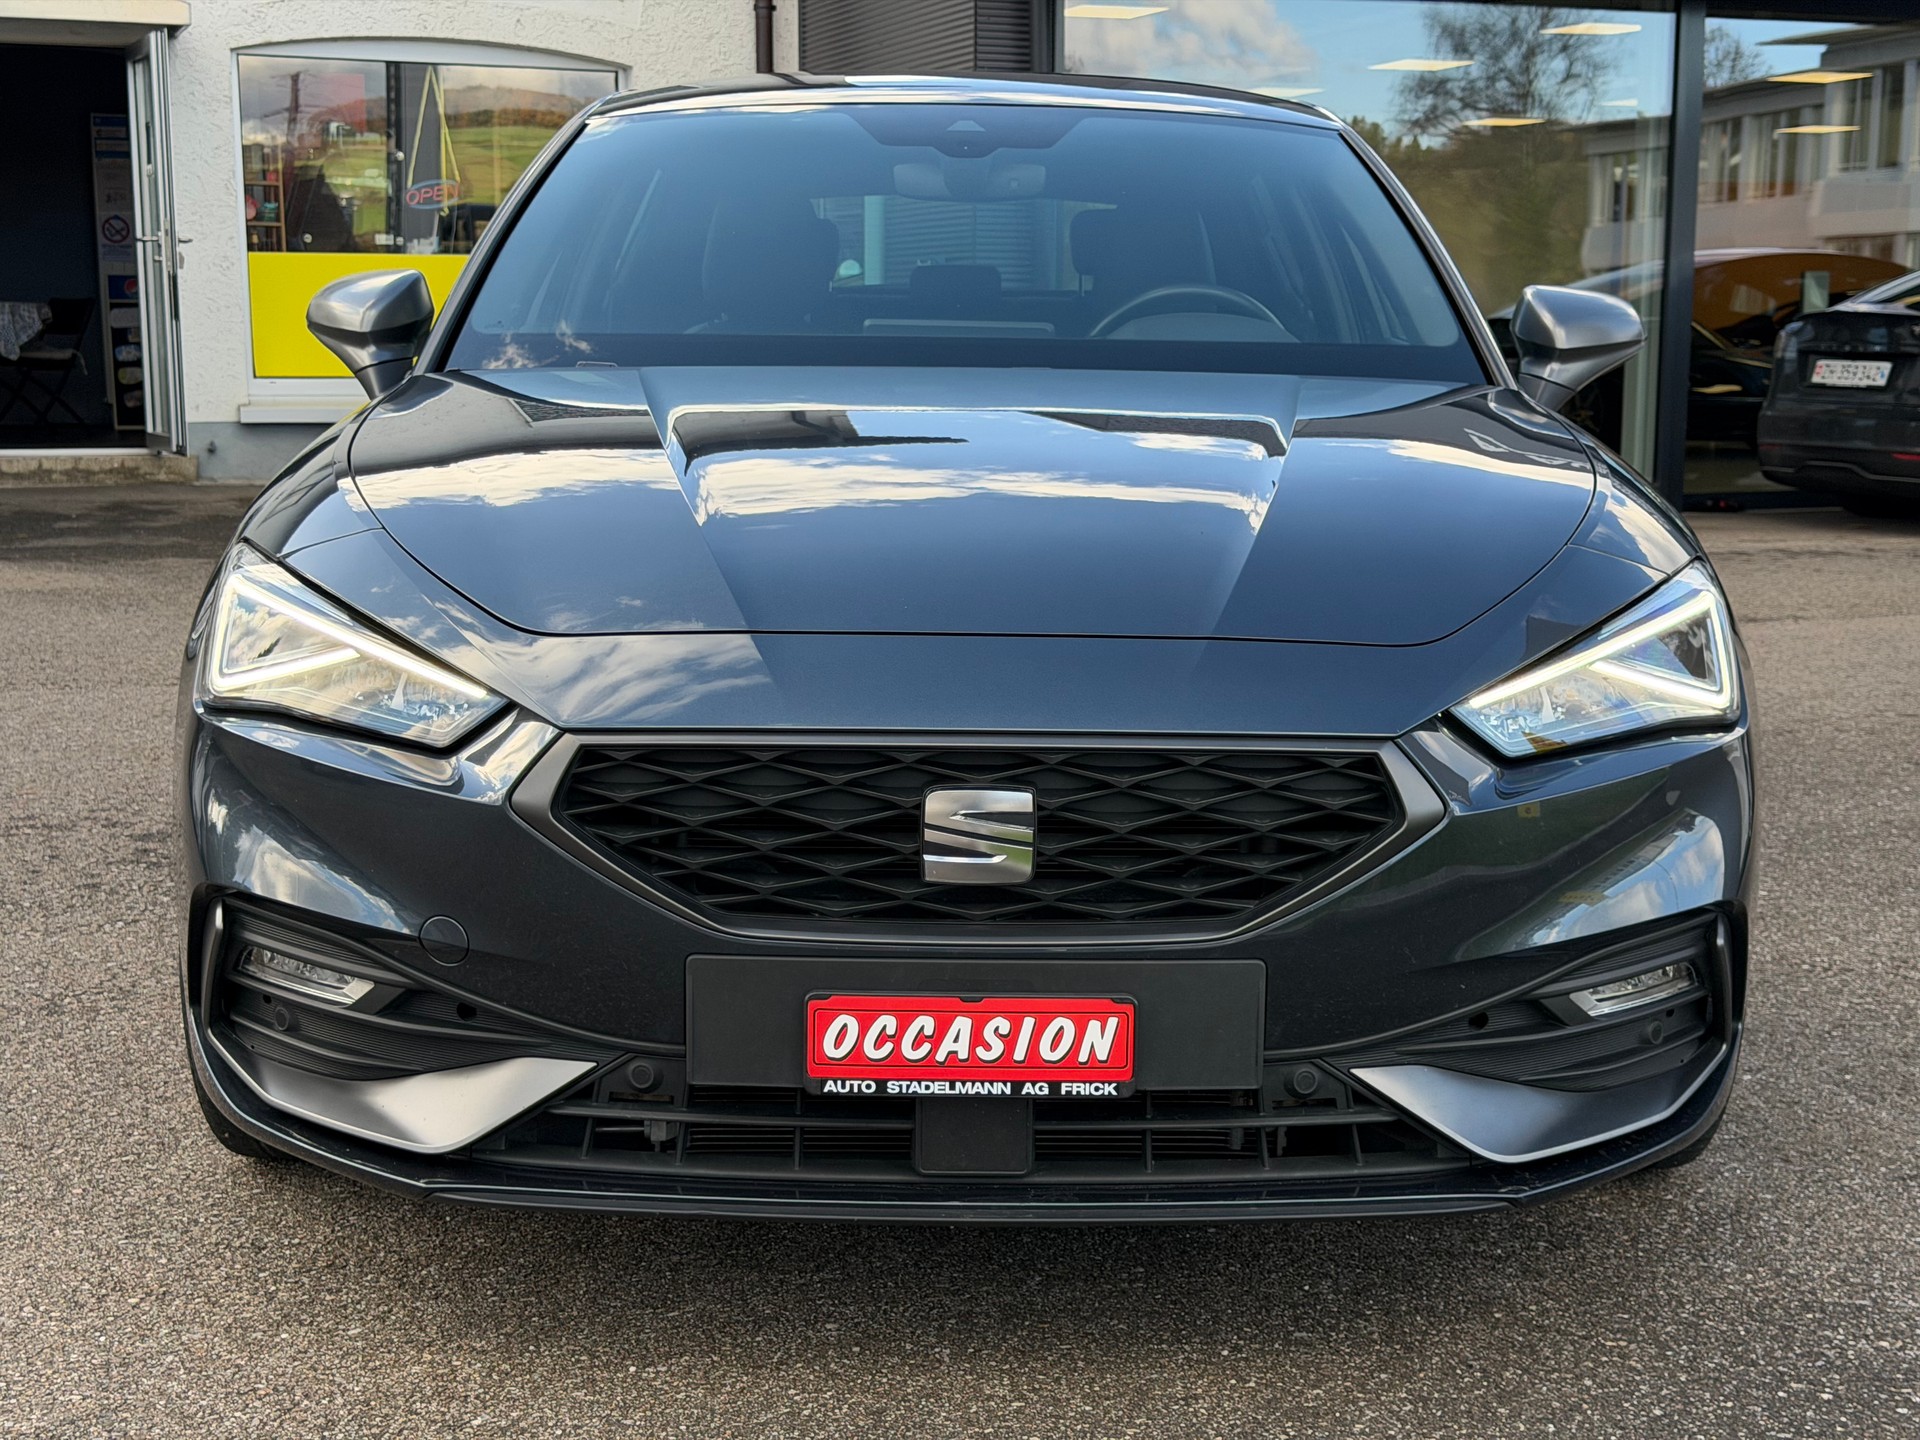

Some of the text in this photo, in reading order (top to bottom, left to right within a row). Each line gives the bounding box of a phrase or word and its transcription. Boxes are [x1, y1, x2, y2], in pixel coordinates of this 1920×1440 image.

[405, 182, 459, 206] OPEN
[822, 1013, 1119, 1065] OCCASION
[823, 1080, 1118, 1096] AUTO STADELMANN AG FRICK
